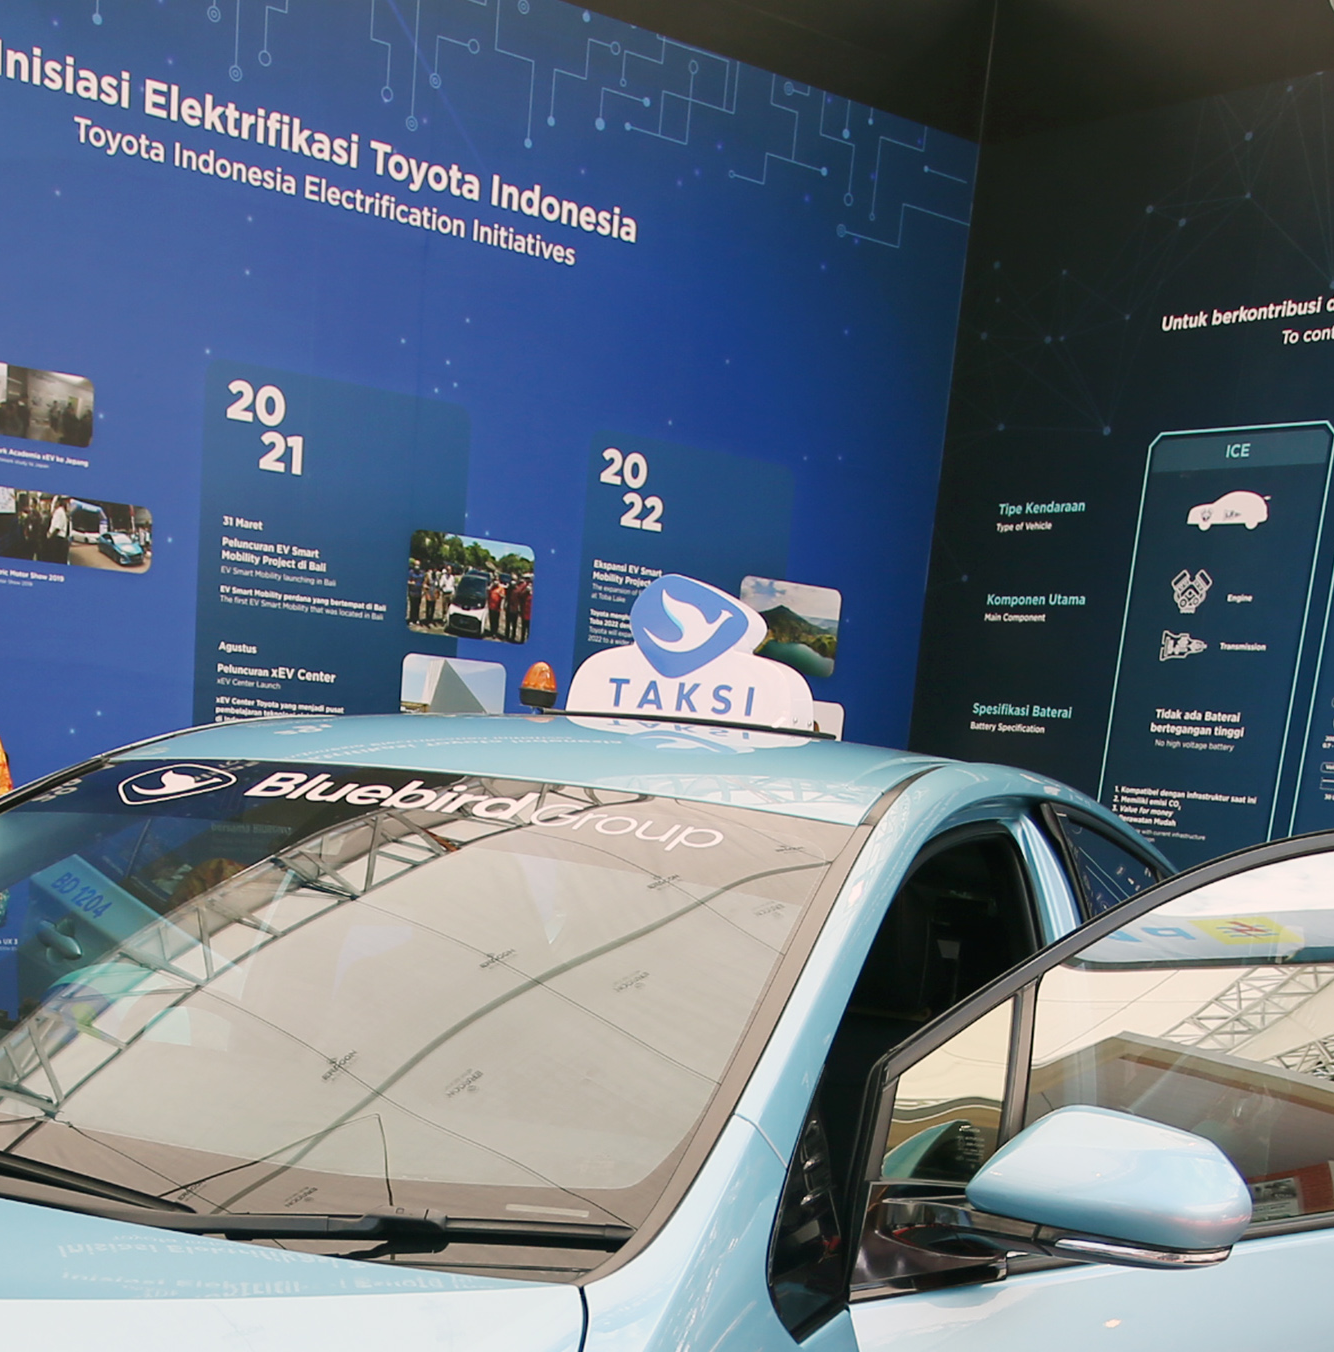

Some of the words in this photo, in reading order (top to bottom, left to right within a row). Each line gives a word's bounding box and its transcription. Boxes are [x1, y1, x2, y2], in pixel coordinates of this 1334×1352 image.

[145, 79, 359, 168] Elektrifikasi
[370, 140, 480, 201] Toyota
[491, 174, 636, 243] Indonesia
[74, 116, 164, 163] Toyota
[175, 142, 296, 195] Indonesia
[305, 175, 465, 238] Electrification
[473, 219, 575, 265] Initiatives
[1162, 311, 1208, 331] Untuk
[1211, 296, 1322, 325] berkontribusi
[1282, 330, 1299, 344] To
[227, 380, 285, 426] 20
[259, 431, 303, 475] 21
[1226, 443, 1251, 458] ICE
[600, 448, 647, 489] 20
[620, 492, 663, 532] 22
[999, 503, 1023, 517] Tipe
[1025, 501, 1085, 514] Kendaraan
[223, 516, 233, 526] 31
[235, 517, 263, 530] Maret
[996, 523, 1014, 533] Type
[1015, 522, 1024, 531] of
[1025, 521, 1052, 530] Vehicle
[222, 536, 275, 552] Peluncuran
[276, 544, 290, 554] EV
[292, 546, 319, 559] Smart
[222, 550, 261, 565] Mobility
[262, 555, 296, 569] Project
[297, 560, 307, 570] di
[309, 561, 326, 572] Bali
[987, 594, 1046, 607] Komponen
[1049, 594, 1086, 605] Utama
[984, 613, 1002, 621] Main
[1003, 613, 1046, 622] Component
[218, 641, 257, 654] Agustus
[217, 663, 269, 677] Peluncuran
[271, 667, 295, 679] xEV
[297, 669, 336, 683] Center
[609, 677, 755, 717] TAKSI
[972, 702, 1030, 716] Spesifikasi
[1032, 705, 1072, 719] Baterai
[1156, 709, 1182, 720] Tidak
[1184, 710, 1202, 721] ada
[1204, 711, 1241, 722] Baterai
[970, 721, 997, 732] Battery
[997, 723, 1045, 733] Specification
[1150, 722, 1212, 737] bertegangan
[1214, 725, 1244, 739] tinggi
